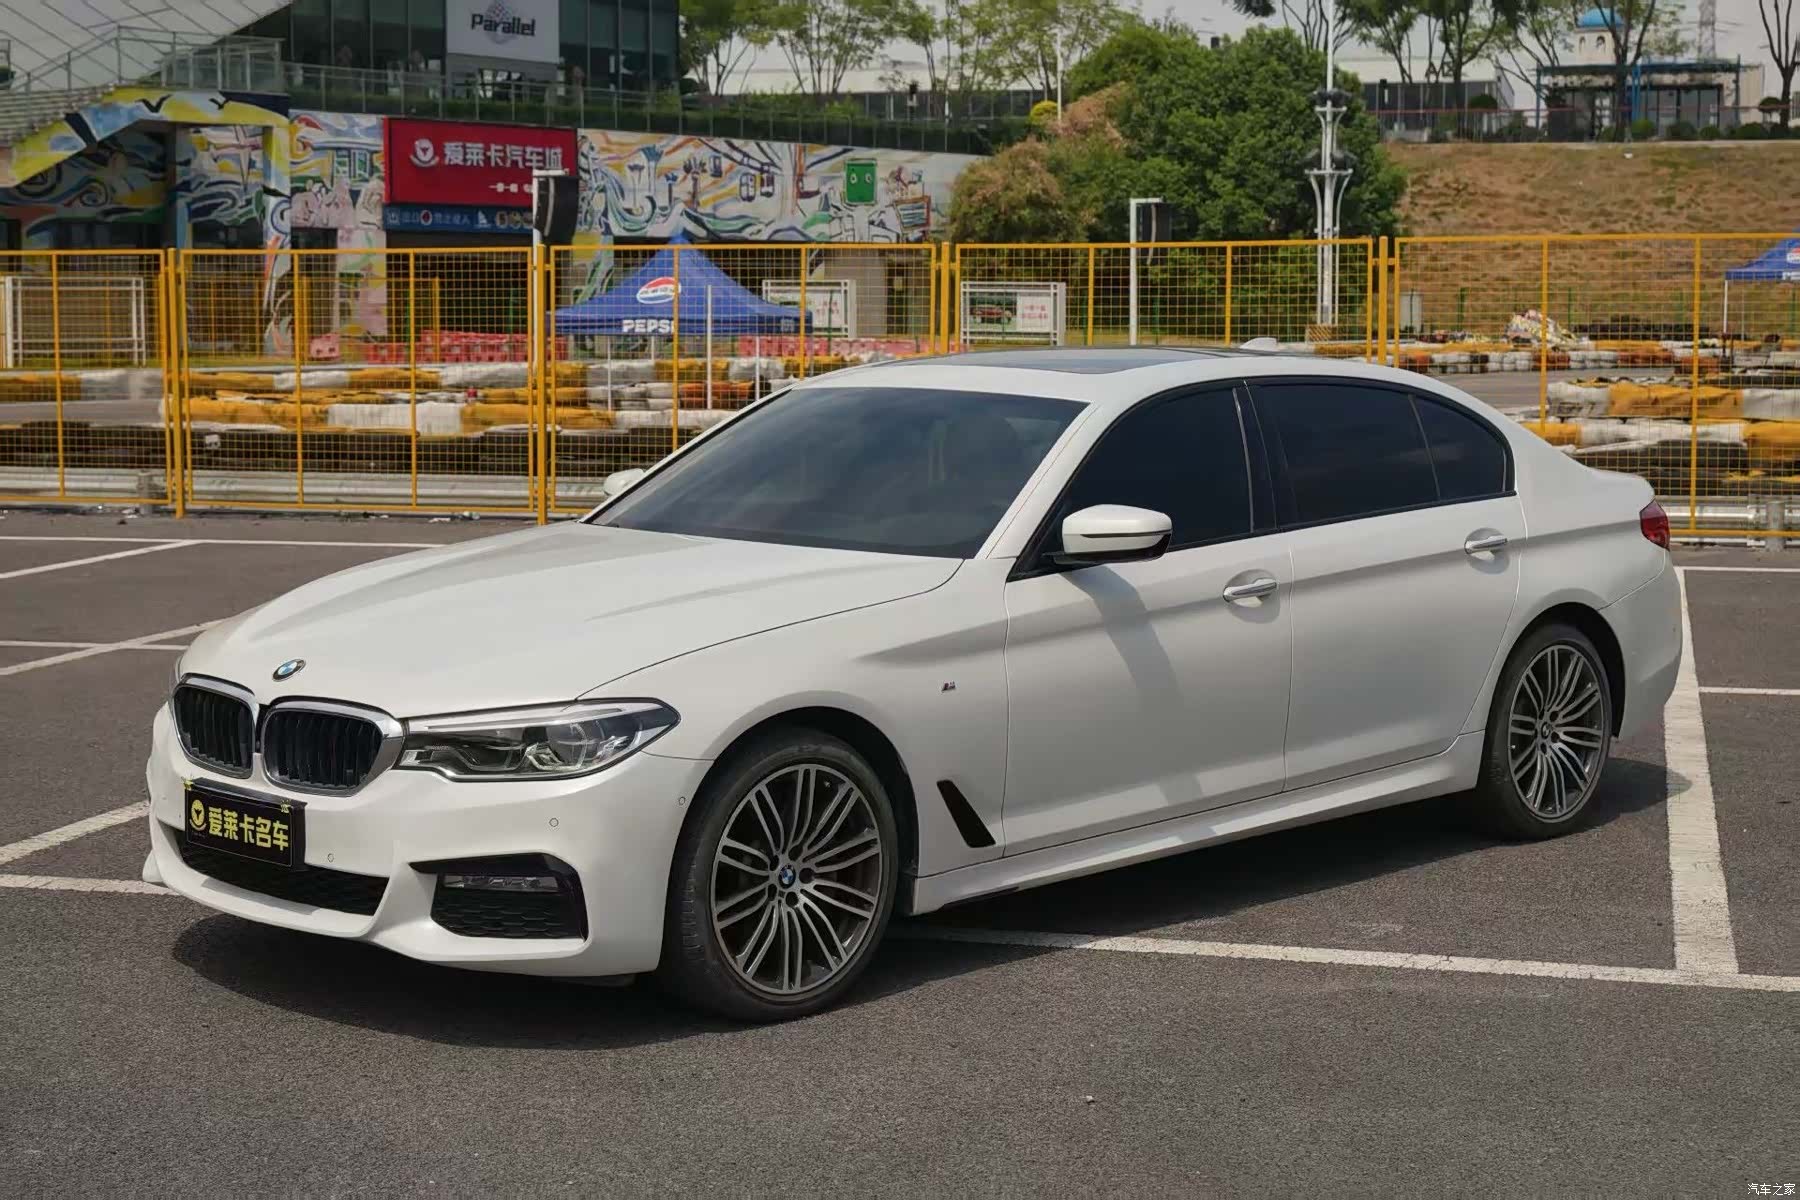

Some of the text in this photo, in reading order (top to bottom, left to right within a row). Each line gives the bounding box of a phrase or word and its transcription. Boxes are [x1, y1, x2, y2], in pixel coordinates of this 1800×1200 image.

[471, 13, 537, 37] Parallel
[443, 140, 563, 171] 爱莱卡汽车城
[208, 806, 289, 851] 爱莱卡名车
